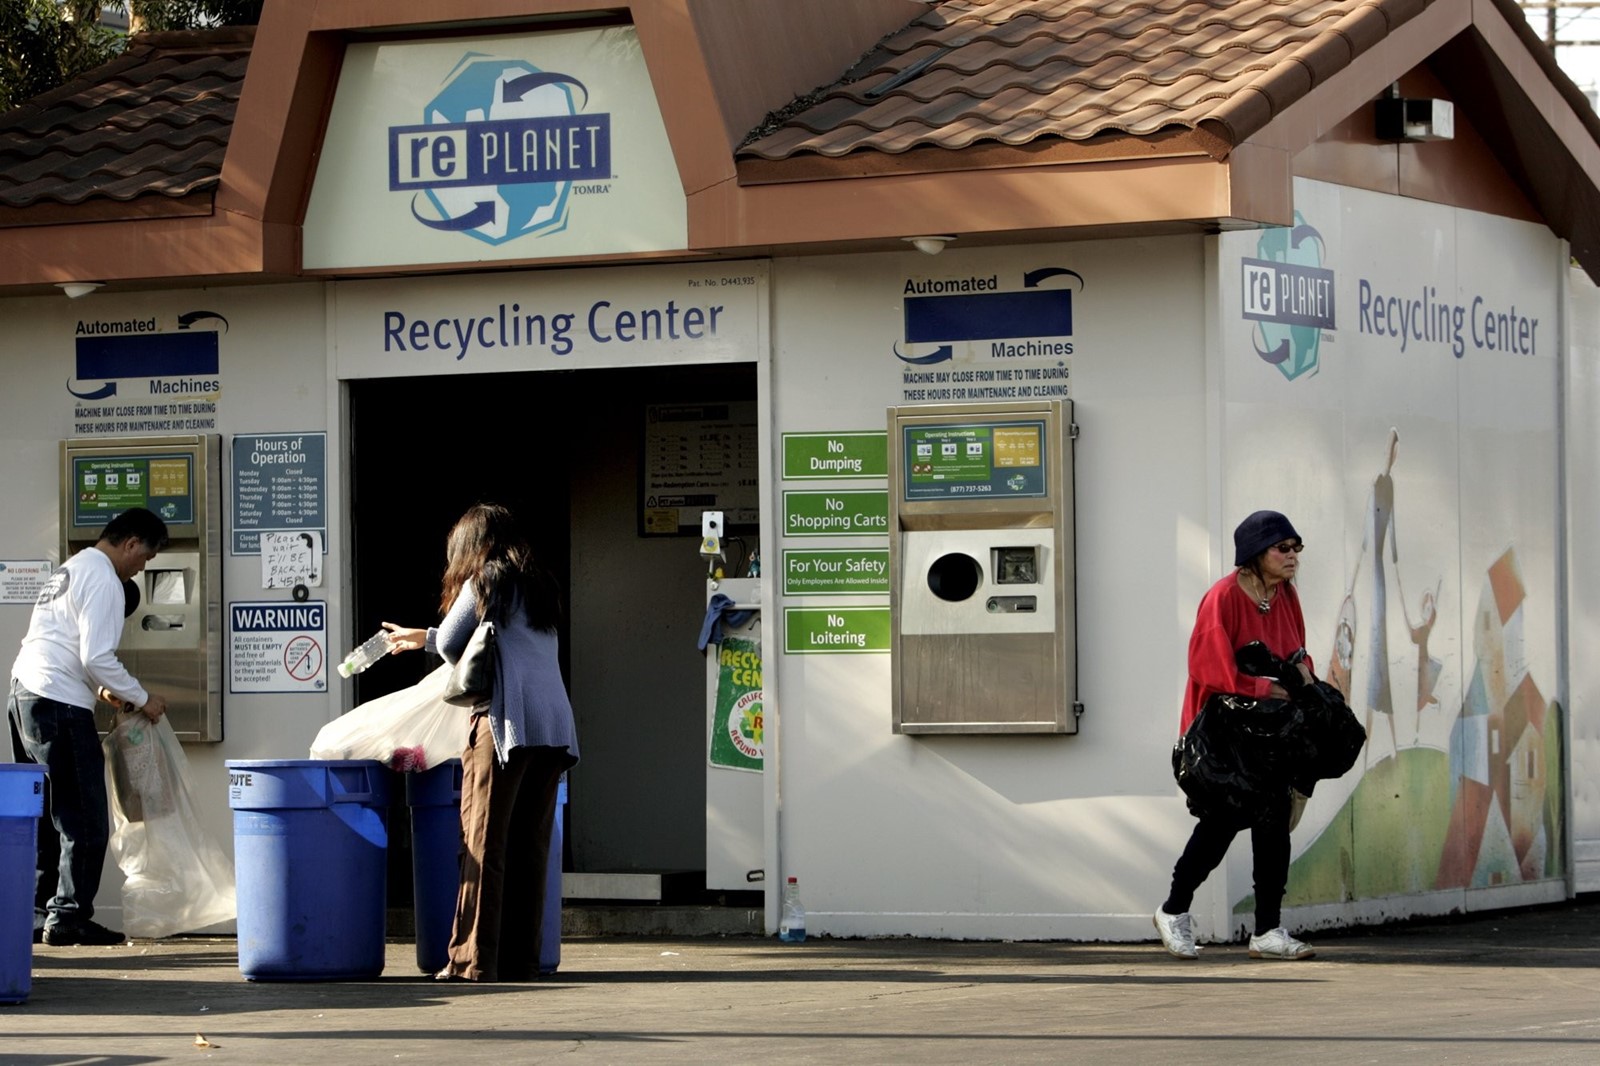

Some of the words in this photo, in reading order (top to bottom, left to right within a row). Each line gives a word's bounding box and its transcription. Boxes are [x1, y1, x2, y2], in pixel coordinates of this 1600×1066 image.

[411, 135, 456, 178] re
[480, 126, 600, 174] PLANET
[903, 275, 998, 294] Automated
[1250, 271, 1271, 311] re
[1281, 273, 1330, 318] PLANET
[75, 317, 155, 334] Automated
[1359, 279, 1465, 358] Recycling
[1471, 296, 1538, 355] Center
[384, 303, 575, 361] Recycling
[588, 301, 723, 343] Center
[991, 340, 1073, 358] Machines
[903, 373, 934, 384] MACHINE
[936, 372, 950, 383] MAY
[952, 371, 973, 382] CLOSE
[975, 371, 994, 382] FROM
[996, 370, 1012, 381] TIME
[1014, 369, 1023, 380] TO
[1024, 369, 1040, 380] TIME
[1042, 367, 1069, 379] DURING
[150, 378, 219, 394] Machines
[904, 390, 925, 400] THESE
[927, 389, 950, 400] HOURS
[952, 388, 966, 399] FOR
[967, 387, 1016, 399] MAINTENANCE
[1017, 386, 1032, 397] AND
[1033, 385, 1068, 397] CLEANING
[75, 407, 101, 418] MACHINE
[102, 407, 114, 417] MAY
[116, 406, 135, 417] CLOSE
[136, 405, 153, 416] FROM
[154, 405, 167, 415] TIME
[169, 405, 177, 415] TO
[178, 404, 192, 414] TIME
[193, 403, 216, 414] DURING
[75, 423, 94, 434] THESE
[95, 422, 115, 433] HOURS
[116, 421, 128, 432] FOR
[129, 420, 171, 431] MAINTENANCE
[172, 420, 184, 430] AND
[185, 418, 214, 429] CLEANING
[255, 439, 288, 451] Hours
[291, 437, 302, 450] of
[828, 440, 844, 453] No
[251, 450, 306, 467] Operation
[810, 456, 862, 472] Dumping
[826, 498, 844, 510] No
[790, 513, 851, 530] Shopping
[854, 513, 887, 527] Carts
[790, 559, 810, 573] For
[812, 559, 842, 572] Your
[845, 557, 886, 574] Safety
[787, 578, 800, 586] Only
[802, 578, 833, 586] Employees
[236, 609, 320, 628] WARNING
[828, 614, 844, 627] No
[811, 630, 866, 646] Loitering
[241, 667, 255, 675] they
